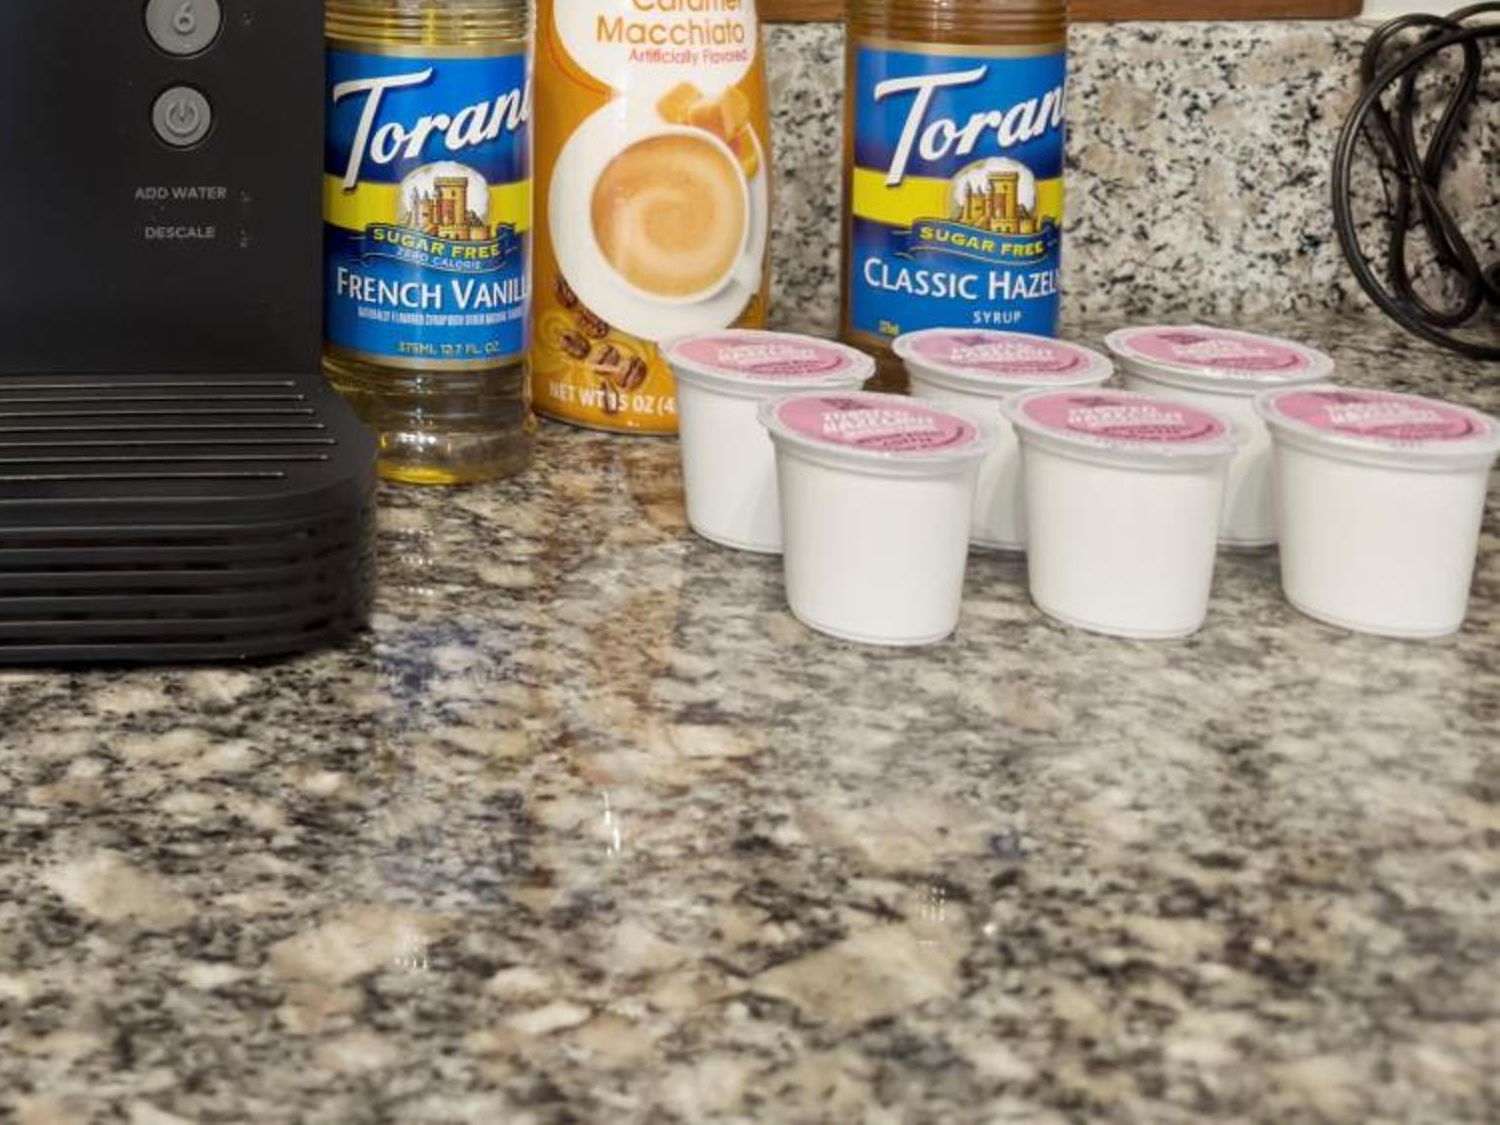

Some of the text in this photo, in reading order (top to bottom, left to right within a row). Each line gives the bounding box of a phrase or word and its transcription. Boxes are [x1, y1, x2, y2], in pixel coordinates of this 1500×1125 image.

[172, 1, 197, 35] 6
[596, 14, 746, 46] Macchiato
[135, 186, 228, 200] ADD WATER
[145, 225, 216, 239] DESCALE
[373, 227, 501, 259] SUGAR FREE
[919, 226, 1045, 257] SUGAR FREE
[336, 266, 442, 310] FRENCH
[863, 258, 1061, 300] CLASSIC HAZEL
[972, 309, 1022, 324] SYRUP
[579, 385, 604, 407] WT
[632, 394, 654, 412] OZ
